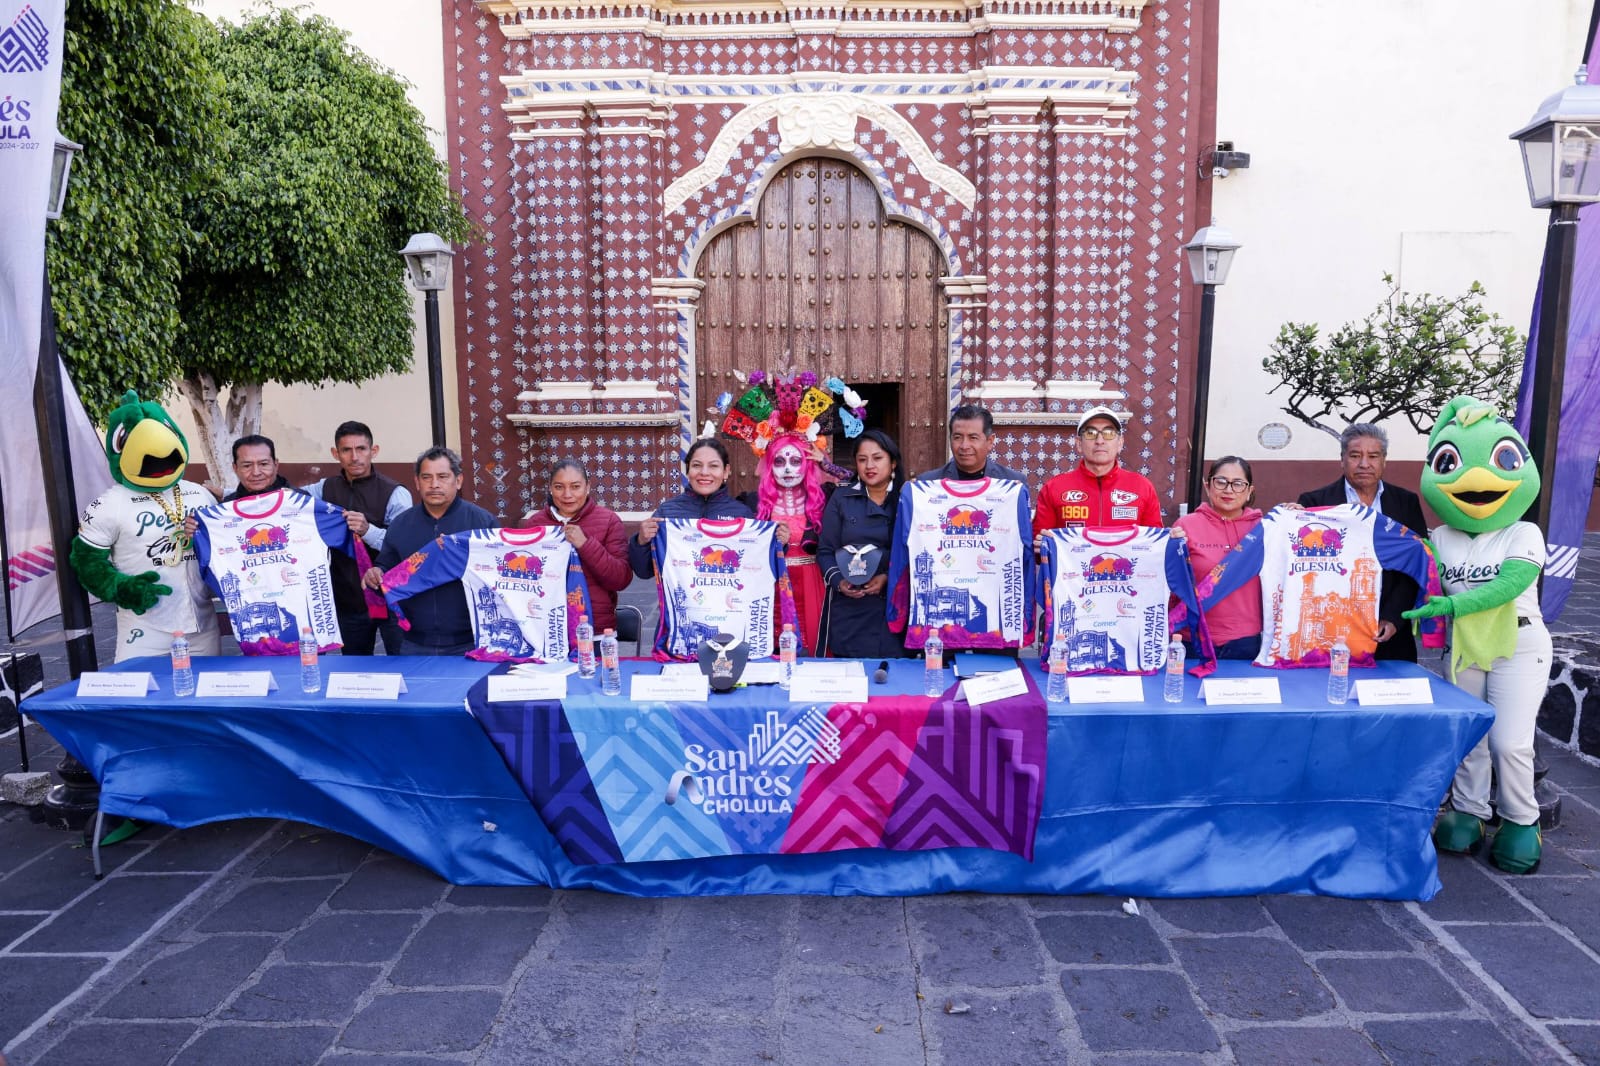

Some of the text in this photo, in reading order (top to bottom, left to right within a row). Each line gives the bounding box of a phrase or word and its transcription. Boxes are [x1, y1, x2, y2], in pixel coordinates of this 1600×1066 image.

[1066, 491, 1083, 500] KC
[1062, 506, 1089, 519] 1960
[939, 539, 993, 551] IGLESIAS
[241, 553, 293, 570] IGLESIAS
[1290, 561, 1344, 575] IGLESIAS
[494, 580, 543, 595] IGLESIAS
[690, 576, 741, 588] IGLESIAS
[1080, 584, 1135, 597] IGLESIAS
[317, 564, 335, 636] TONANTZINTLA
[313, 603, 325, 634] SANTA
[1004, 596, 1013, 628] SANTA
[684, 744, 746, 772] San
[703, 799, 793, 815] CHOLULA
